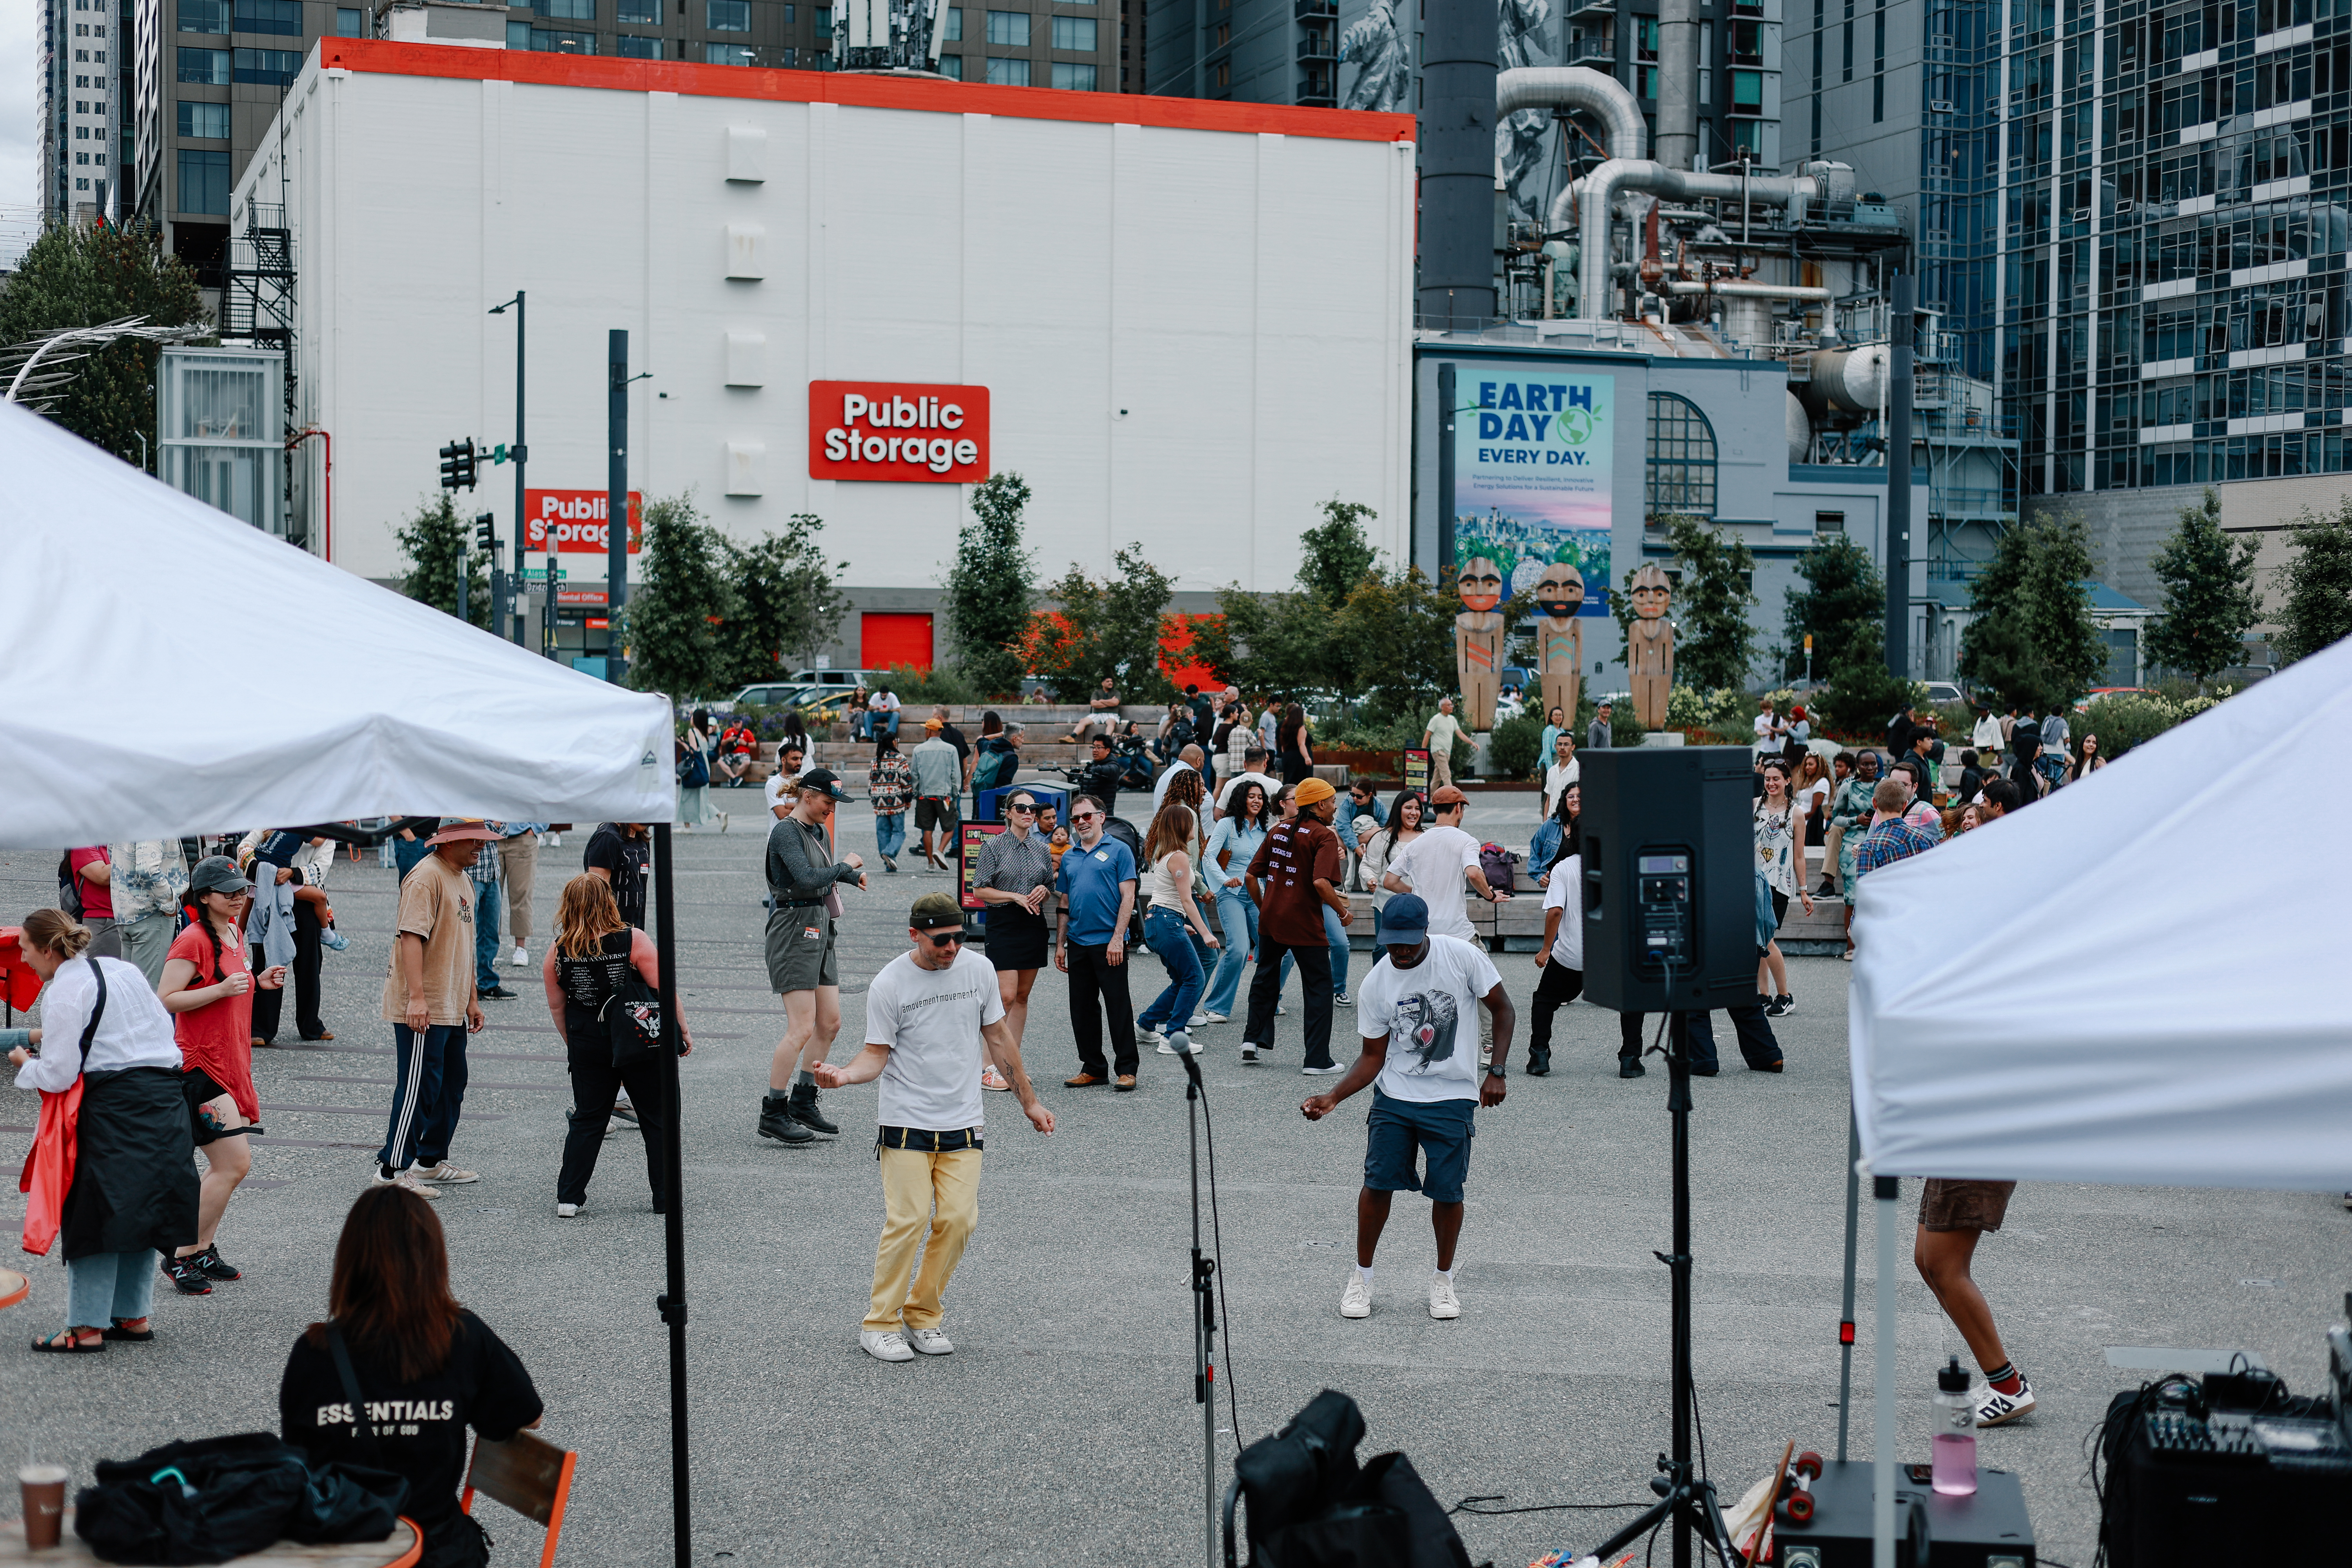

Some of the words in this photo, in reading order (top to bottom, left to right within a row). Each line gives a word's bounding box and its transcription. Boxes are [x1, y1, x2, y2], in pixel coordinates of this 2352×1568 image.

[1480, 382, 1592, 414] EARTH
[844, 393, 964, 430] Public
[1479, 412, 1552, 442] DAY
[825, 427, 978, 473] Storage
[1479, 448, 1541, 464] EVERY
[1546, 450, 1590, 465] DAY.
[542, 496, 609, 520] Publi
[1273, 834, 1289, 843] QUIE
[638, 1007, 646, 1015] HATE
[902, 989, 973, 1013] amovementmovement
[351, 1426, 379, 1438] FR
[382, 1424, 396, 1436] OF
[400, 1424, 420, 1436] GOD
